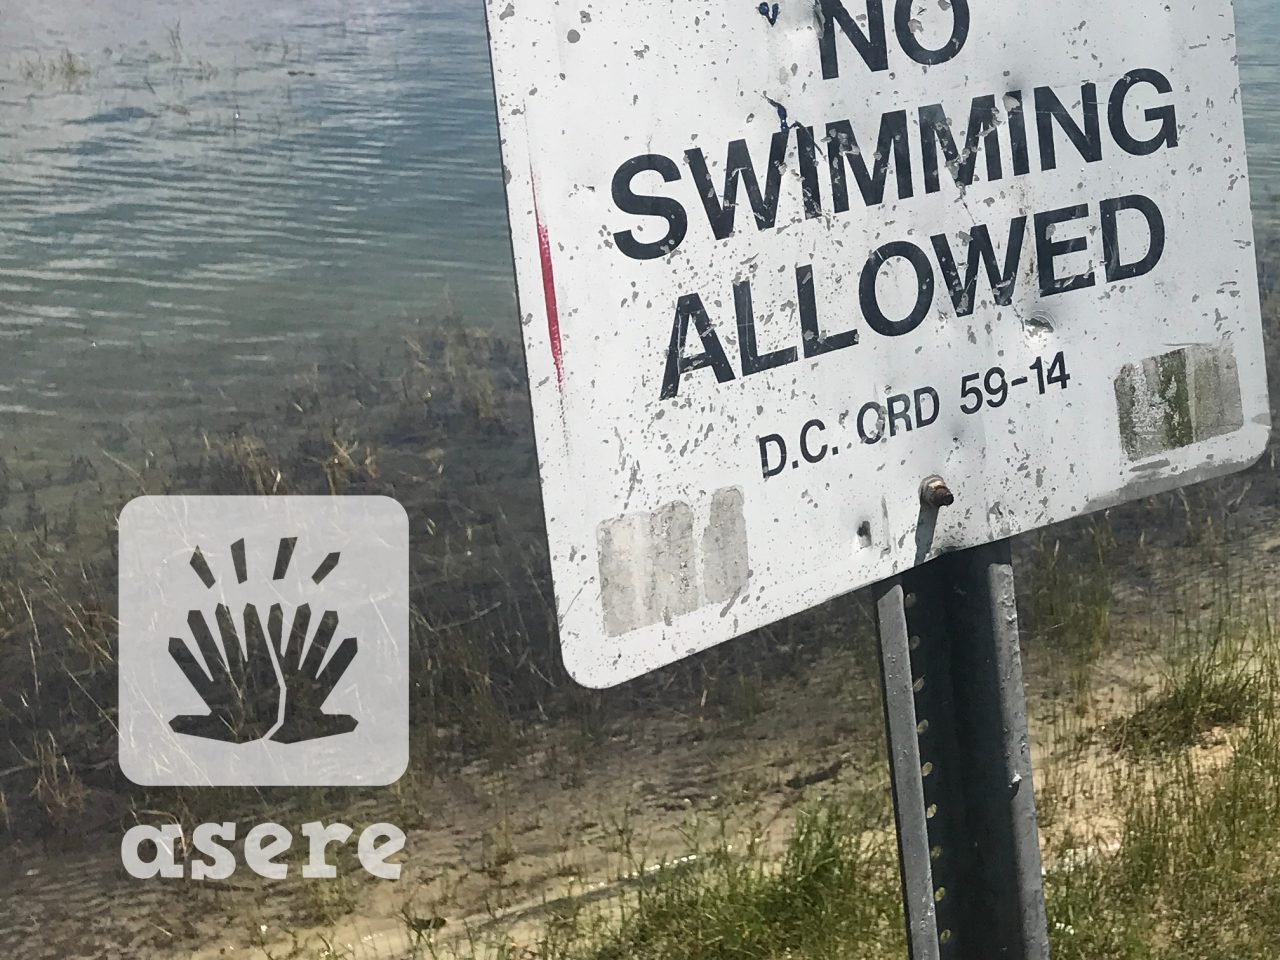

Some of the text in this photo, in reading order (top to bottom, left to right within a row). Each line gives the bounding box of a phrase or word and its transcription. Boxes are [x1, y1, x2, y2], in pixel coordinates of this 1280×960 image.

[611, 67, 1179, 260] SWIMMING
[660, 193, 1166, 400] ALLOWED
[758, 351, 1071, 478] D.C. ORD 59-14
